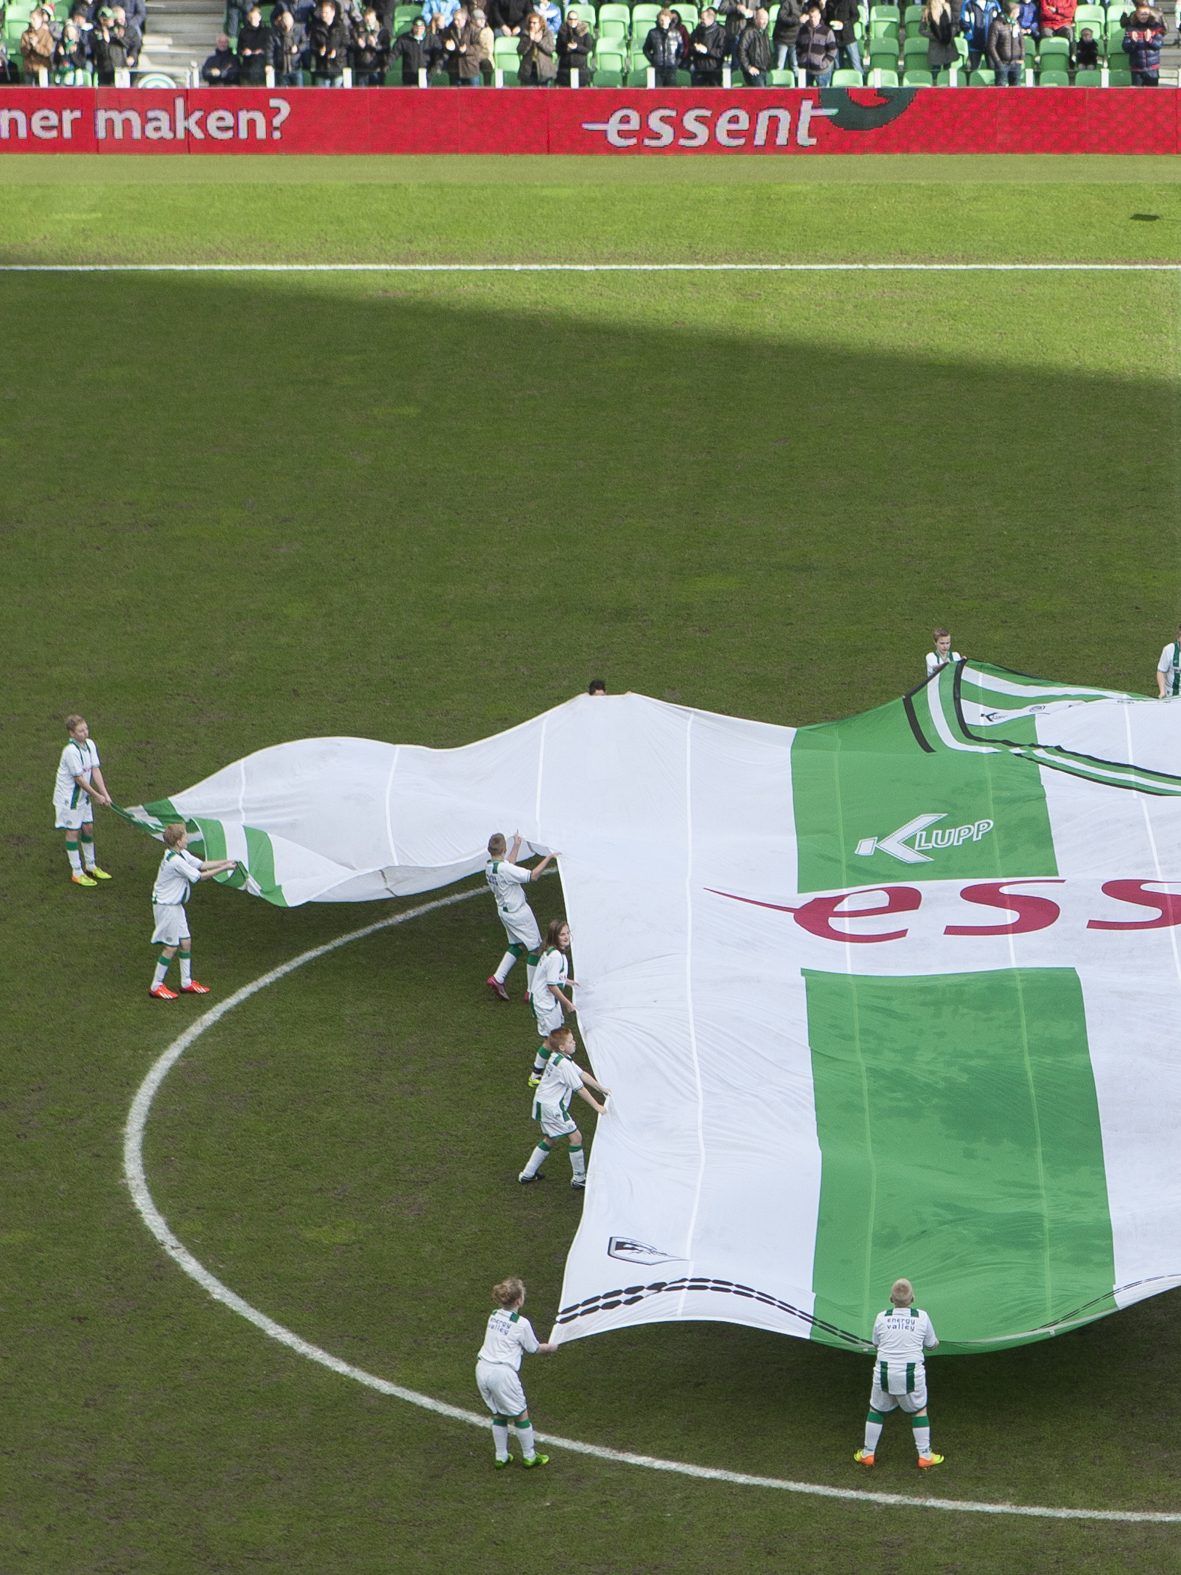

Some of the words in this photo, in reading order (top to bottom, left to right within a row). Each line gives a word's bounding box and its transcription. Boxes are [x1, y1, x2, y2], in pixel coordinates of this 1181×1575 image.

[95, 96, 291, 140] maken?
[581, 98, 839, 147] essent
[887, 1324, 915, 1332] valley
